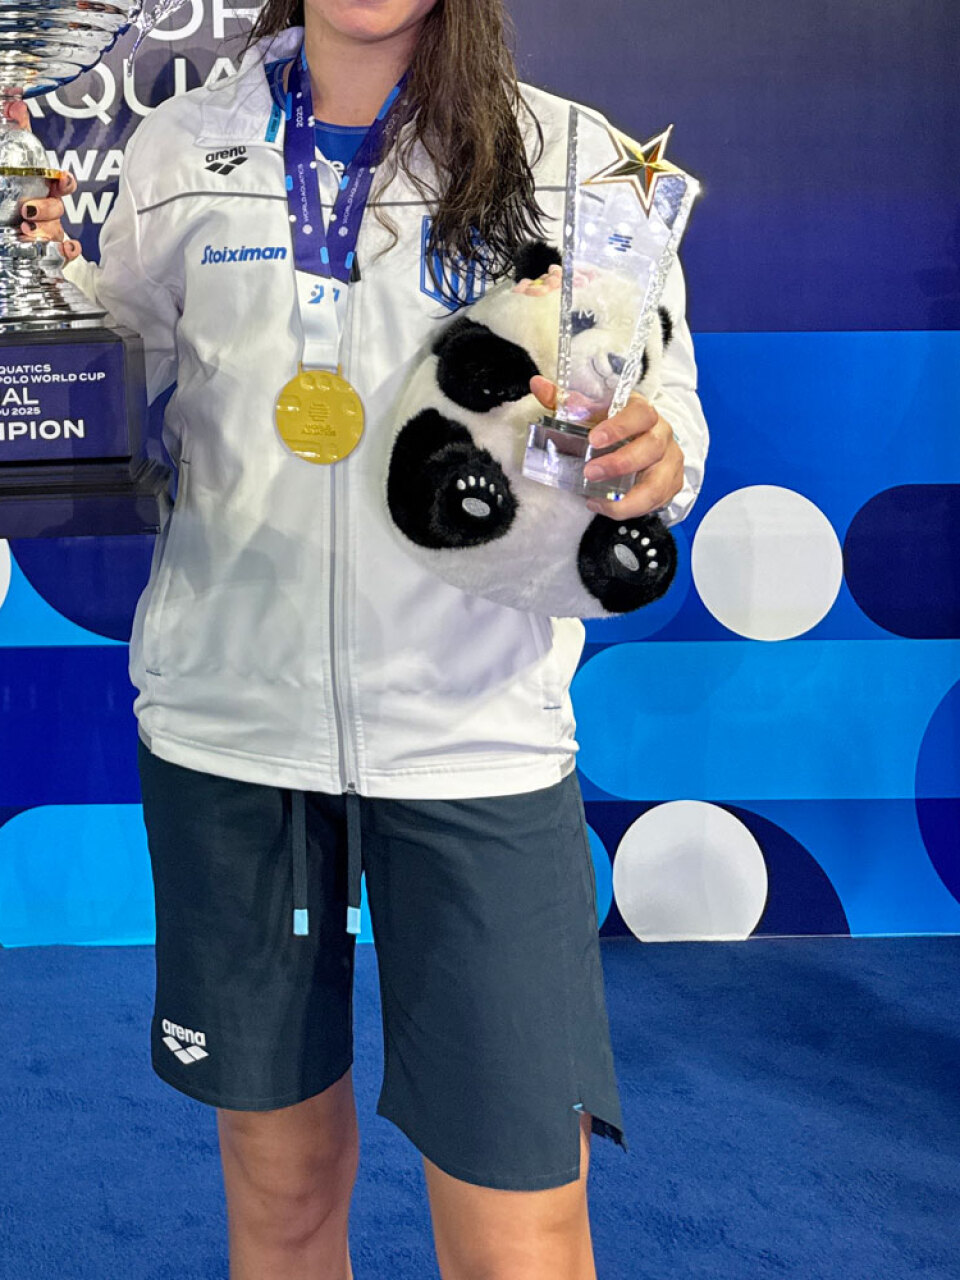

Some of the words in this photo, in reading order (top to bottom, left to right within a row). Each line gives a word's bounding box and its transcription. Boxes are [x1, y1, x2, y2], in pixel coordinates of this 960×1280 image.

[205, 145, 247, 163] arena
[201, 245, 287, 265] Stoiximan
[31, 373, 77, 383] WORLD
[79, 372, 106, 381] CUP
[11, 407, 41, 416] 2025
[162, 1018, 206, 1047] arena
